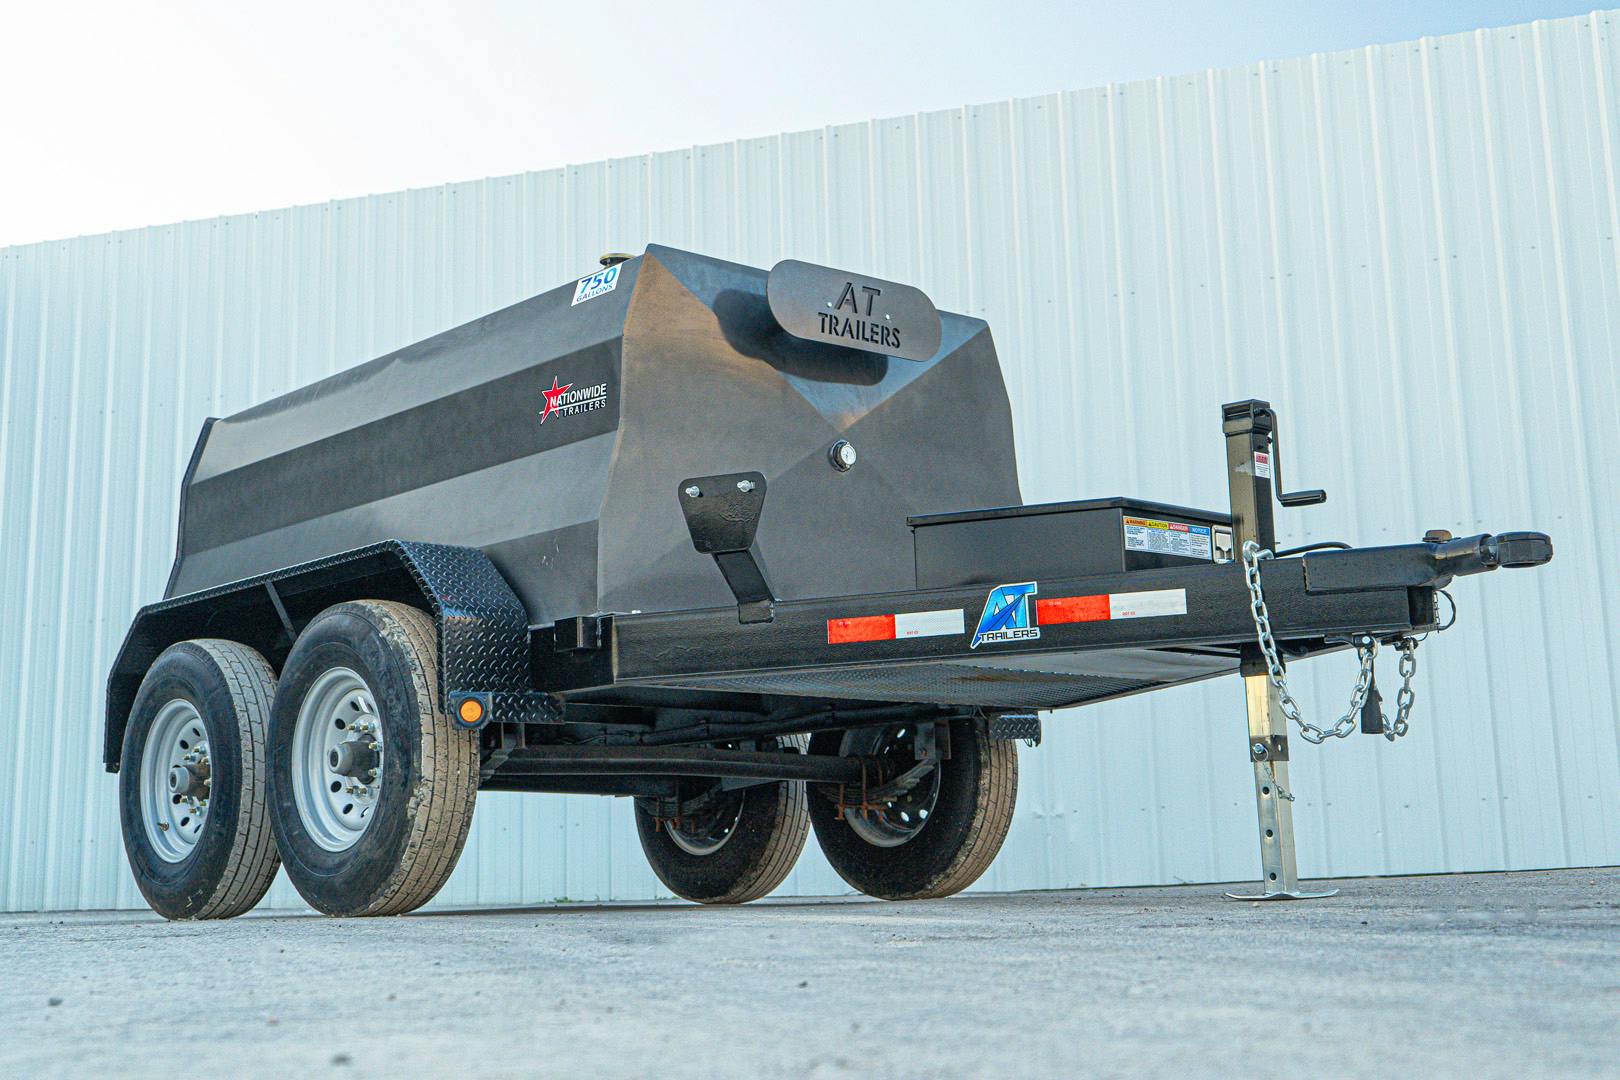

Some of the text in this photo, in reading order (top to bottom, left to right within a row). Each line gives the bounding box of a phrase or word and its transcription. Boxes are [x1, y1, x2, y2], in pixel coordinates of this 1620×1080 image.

[576, 283, 613, 302] GALLONS
[581, 267, 617, 294] 750
[834, 281, 881, 317] AT
[818, 311, 901, 349] TRAILERS
[550, 383, 607, 407] NATIONWIDE
[563, 399, 606, 417] TRAILERS
[1151, 520, 1168, 528] CAUTION
[973, 583, 1035, 642] AT
[979, 629, 1038, 642] TRAILERS
